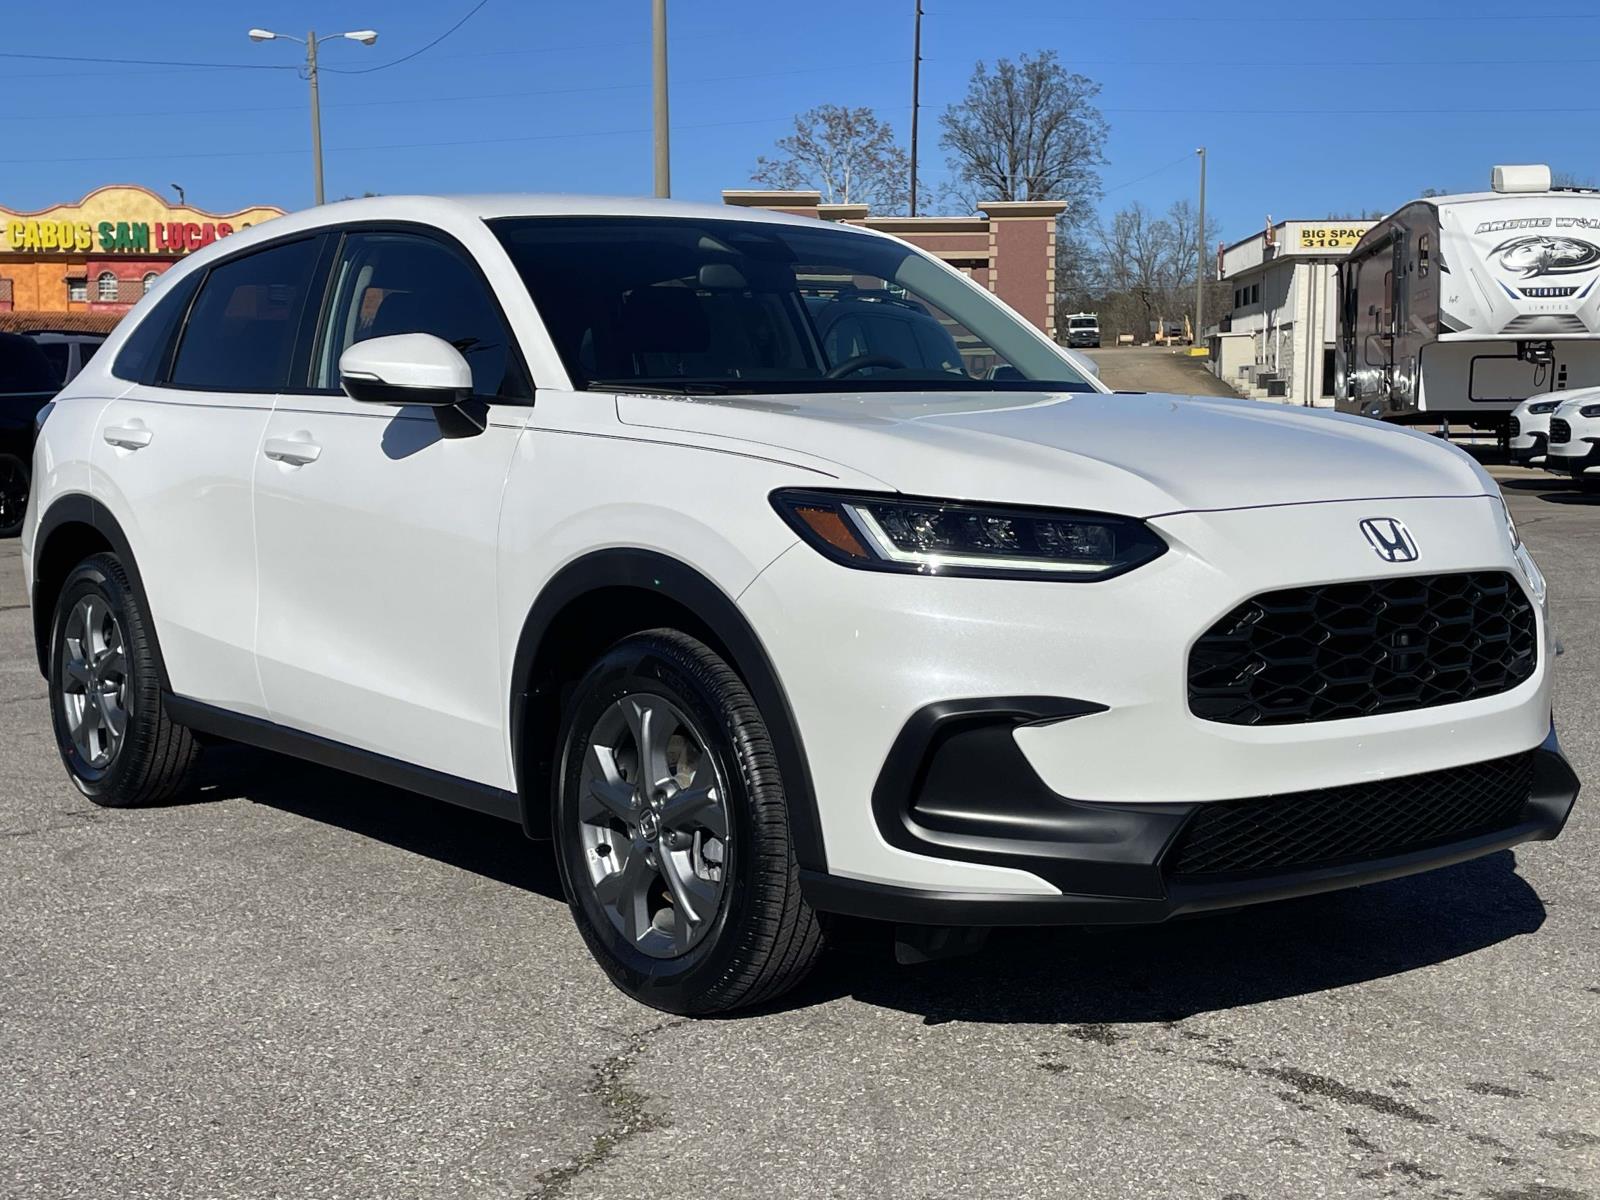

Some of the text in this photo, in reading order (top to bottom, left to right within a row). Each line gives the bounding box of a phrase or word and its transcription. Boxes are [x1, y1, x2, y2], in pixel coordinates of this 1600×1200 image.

[1474, 217, 1552, 234] ARCTIC
[7, 220, 92, 249] CABOS
[98, 220, 149, 249] SAN
[1302, 229, 1366, 239] BIG SPAC
[1303, 239, 1340, 248] 310
[1526, 287, 1571, 297] CHEROKEE
